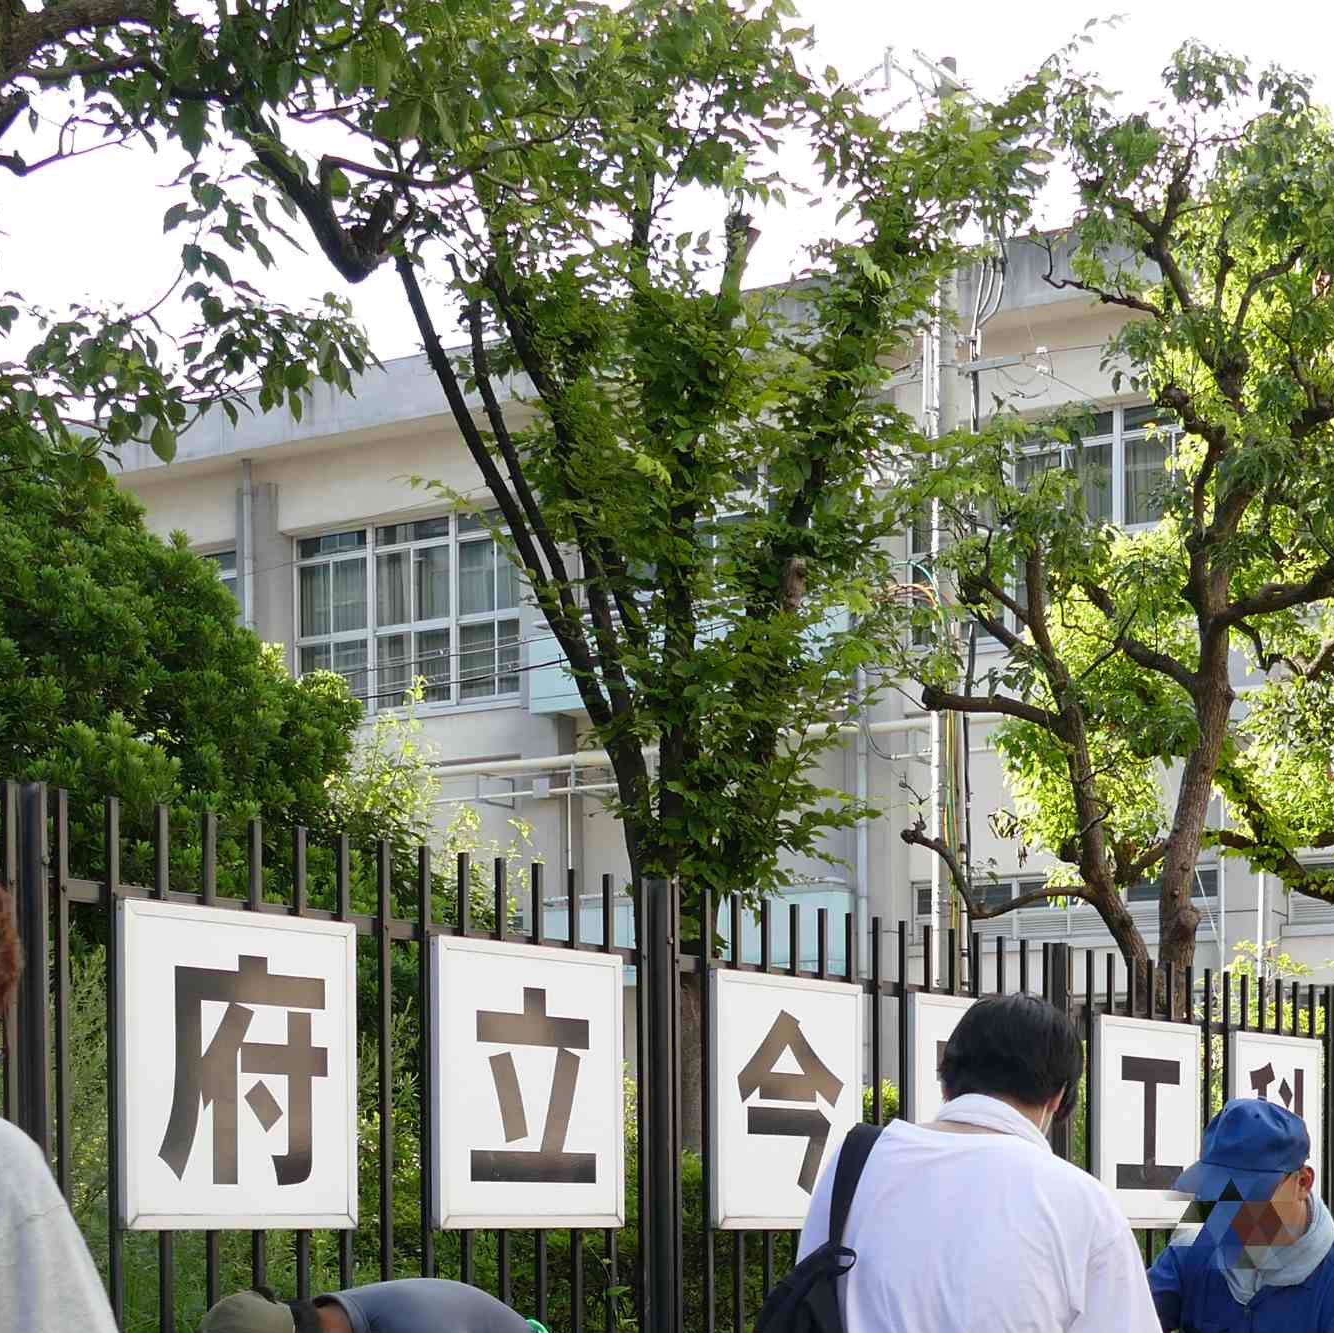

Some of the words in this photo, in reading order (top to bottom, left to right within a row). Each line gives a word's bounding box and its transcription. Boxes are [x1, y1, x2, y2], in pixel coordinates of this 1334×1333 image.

[158, 954, 328, 1186] 府
[470, 986, 596, 1184] 立
[737, 1009, 844, 1195] 今
[1116, 1056, 1181, 1189] 工
